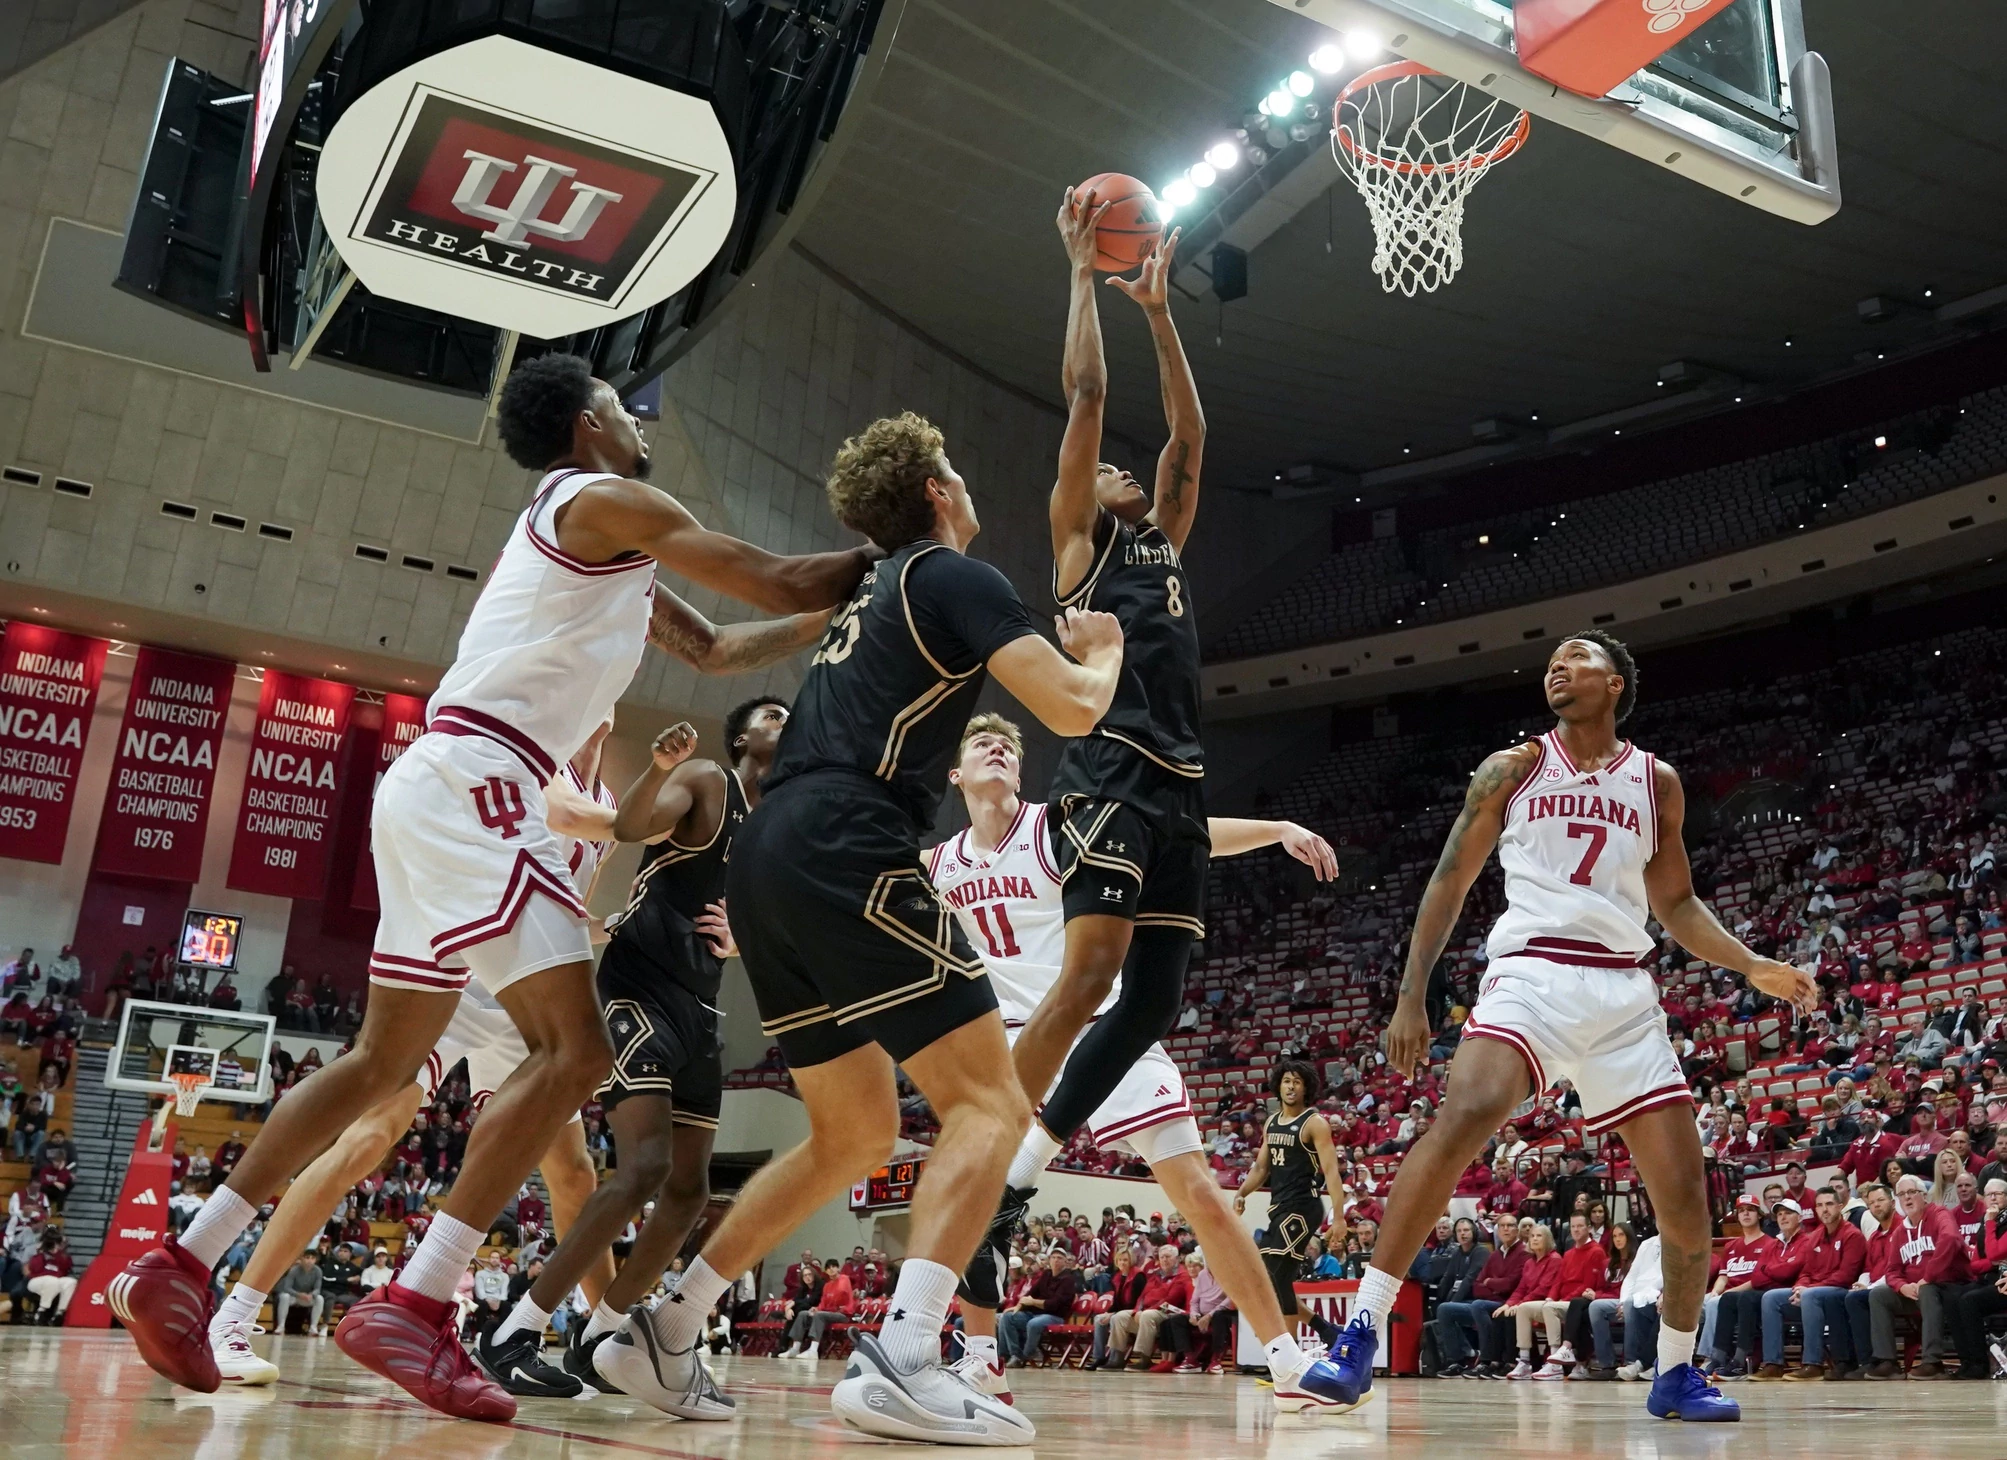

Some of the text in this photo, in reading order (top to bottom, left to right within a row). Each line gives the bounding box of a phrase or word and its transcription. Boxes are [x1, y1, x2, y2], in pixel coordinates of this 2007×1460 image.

[385, 219, 604, 291] HEALTH
[1124, 542, 1183, 571] LINDEN
[1166, 575, 1183, 617] 8
[17, 651, 84, 681] INDIANA
[1, 673, 90, 707] UNIVERSITY
[150, 676, 214, 705] INDIANA
[134, 698, 221, 729] UNIVERSITY
[274, 698, 335, 728] INDIANA
[122, 727, 213, 770] NCAA
[260, 719, 342, 752] UNIVERSITY
[0, 747, 72, 778] SKETBALL
[251, 748, 335, 790] NCAA
[0, 773, 66, 802] AMPIONS
[118, 768, 204, 799] BASKETBALL
[0, 805, 37, 830] 953
[117, 793, 199, 823] CHAMPIONS
[247, 788, 328, 819] BASKETBALL
[1528, 794, 1641, 837] INDIANA
[134, 827, 174, 850] 1976
[246, 813, 324, 841] CHAMPIONS
[264, 846, 297, 869] 1981
[1567, 822, 1608, 886] 7
[944, 876, 1037, 910] INDIANA
[204, 918, 237, 936] 1:27
[972, 903, 1021, 958] 11
[189, 932, 228, 963] 30
[1270, 1147, 1285, 1166] 34
[120, 1227, 157, 1242] meijer
